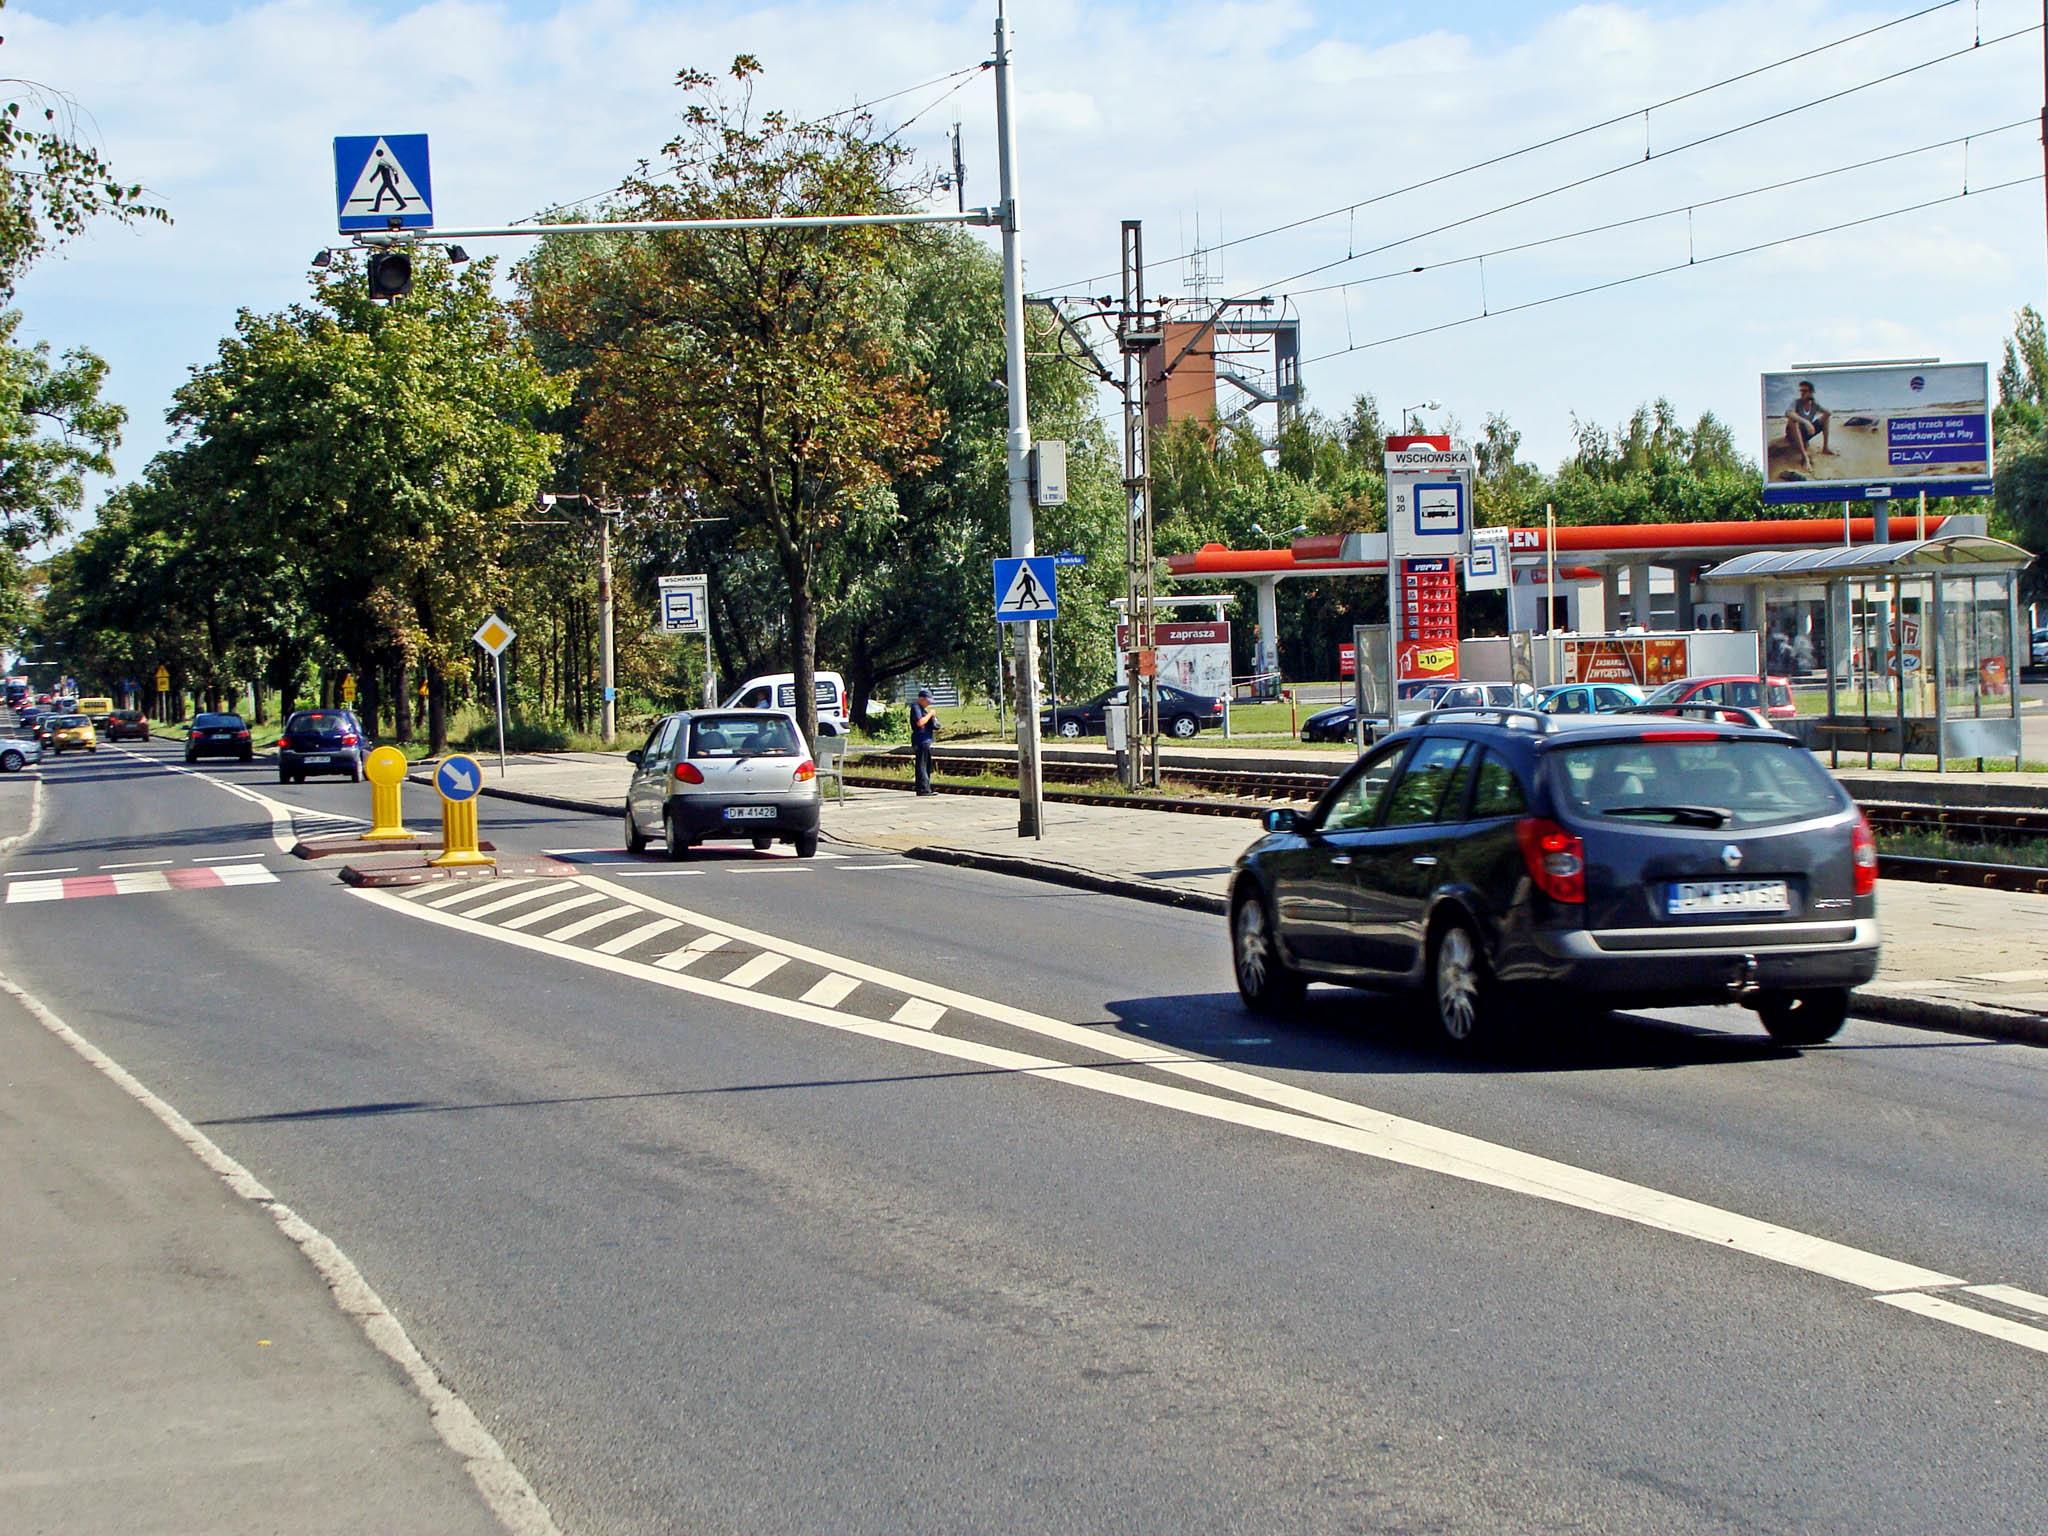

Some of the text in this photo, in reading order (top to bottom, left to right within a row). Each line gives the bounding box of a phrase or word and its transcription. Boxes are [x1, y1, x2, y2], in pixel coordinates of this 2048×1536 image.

[1945, 419, 1964, 428] sieci
[1957, 430, 1974, 439] Play
[1395, 453, 1468, 464] WSCHOWSKA
[1892, 450, 1934, 462] PLAY
[1396, 495, 1405, 503] 10
[1396, 504, 1406, 513] 20
[1170, 630, 1216, 640] zaprasza
